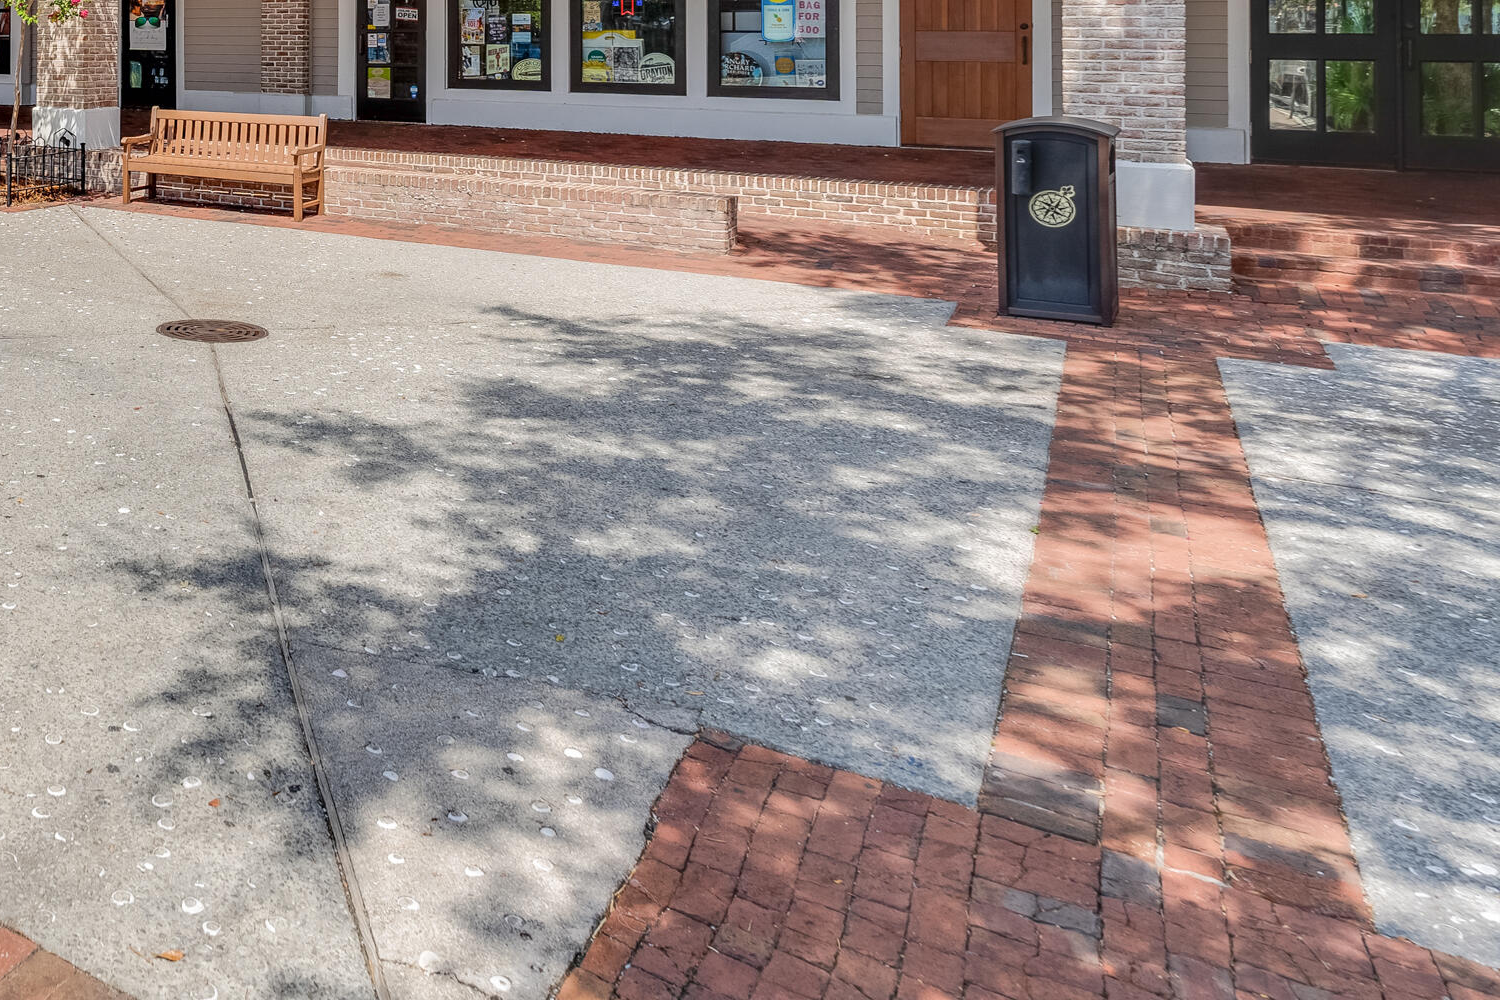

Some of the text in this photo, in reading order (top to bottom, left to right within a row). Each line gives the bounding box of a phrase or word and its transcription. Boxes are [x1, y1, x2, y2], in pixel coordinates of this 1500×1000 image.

[799, 1, 821, 9] BAG
[798, 12, 820, 20] FOR
[722, 64, 755, 72] RCHARD
[641, 66, 673, 80] GRAYTON
